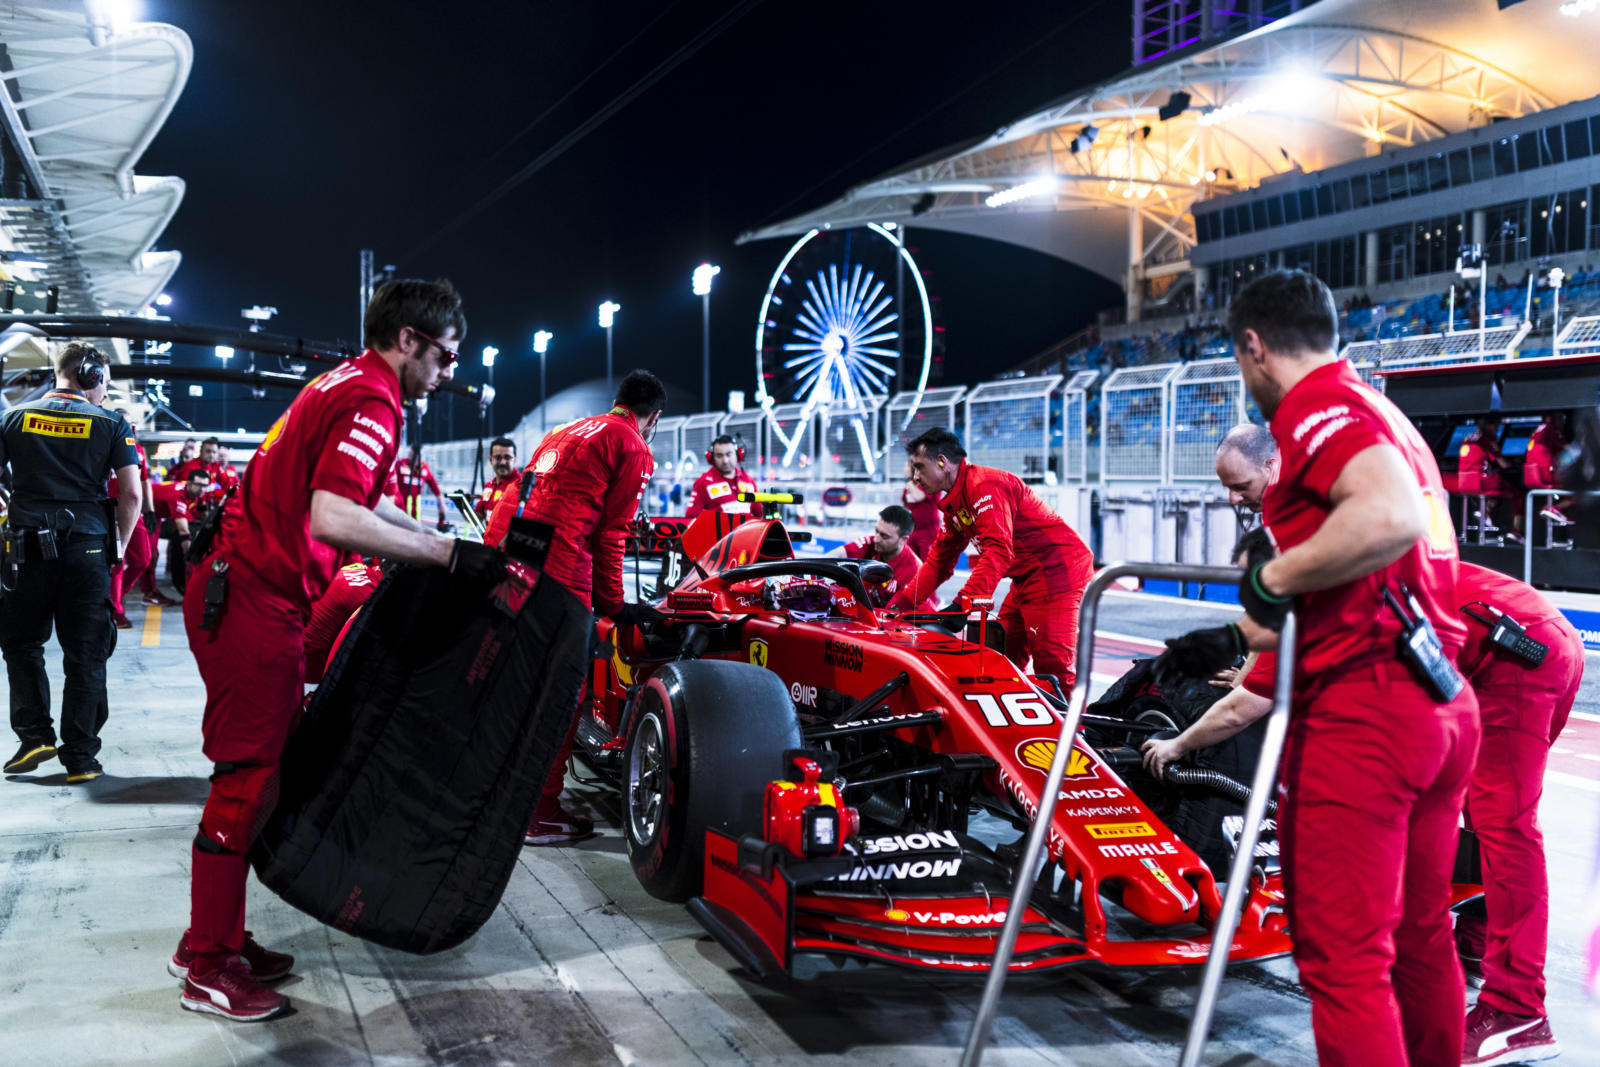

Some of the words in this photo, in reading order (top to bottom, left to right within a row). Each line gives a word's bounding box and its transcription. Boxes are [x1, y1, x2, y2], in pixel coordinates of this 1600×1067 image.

[28, 417, 85, 434] PIRELLI
[353, 412, 392, 444] Lenovo
[825, 638, 863, 660] MISSION
[824, 652, 863, 673] WINNOW
[963, 691, 1055, 727] 16
[832, 711, 923, 729] Lenovo
[1058, 787, 1106, 800] AMD
[1066, 806, 1133, 818] KASPERSKY
[1093, 825, 1148, 835] PIRELLI
[844, 829, 960, 856] SSION
[1098, 841, 1179, 858] MAHLE
[838, 858, 962, 882] INNOW
[912, 911, 1008, 925] V-Powe
